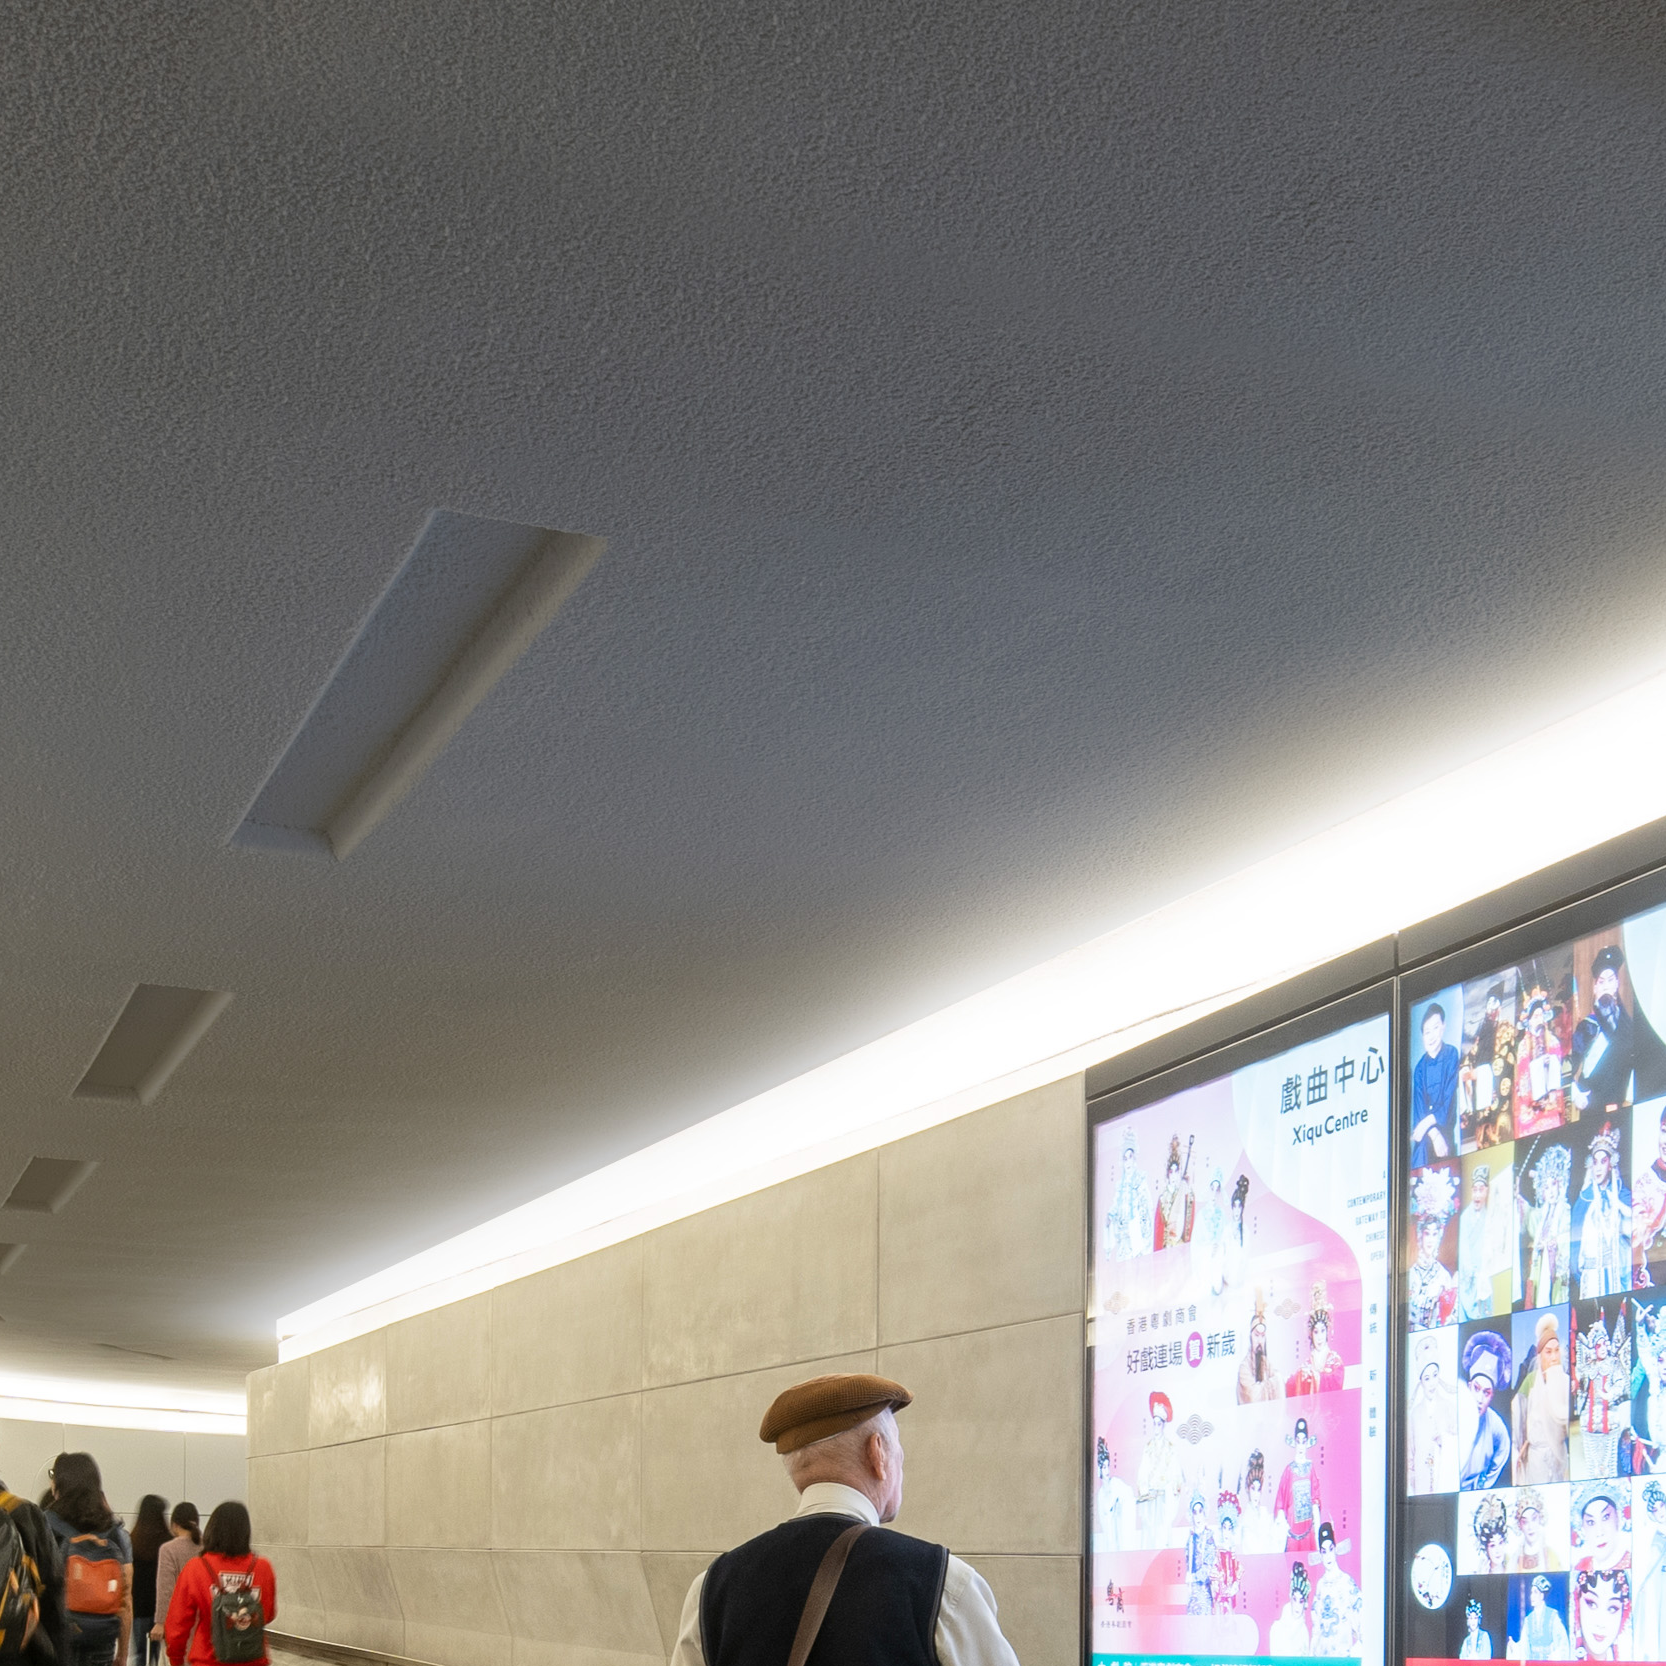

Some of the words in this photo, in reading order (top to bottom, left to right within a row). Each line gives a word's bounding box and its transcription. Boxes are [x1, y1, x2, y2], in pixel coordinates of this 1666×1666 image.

[1280, 1047, 1385, 1114] 戲曲中心
[1293, 1124, 1322, 1145] Xiqu
[1324, 1109, 1368, 1134] Centre
[1127, 1304, 1196, 1335] 香港粵劇商會
